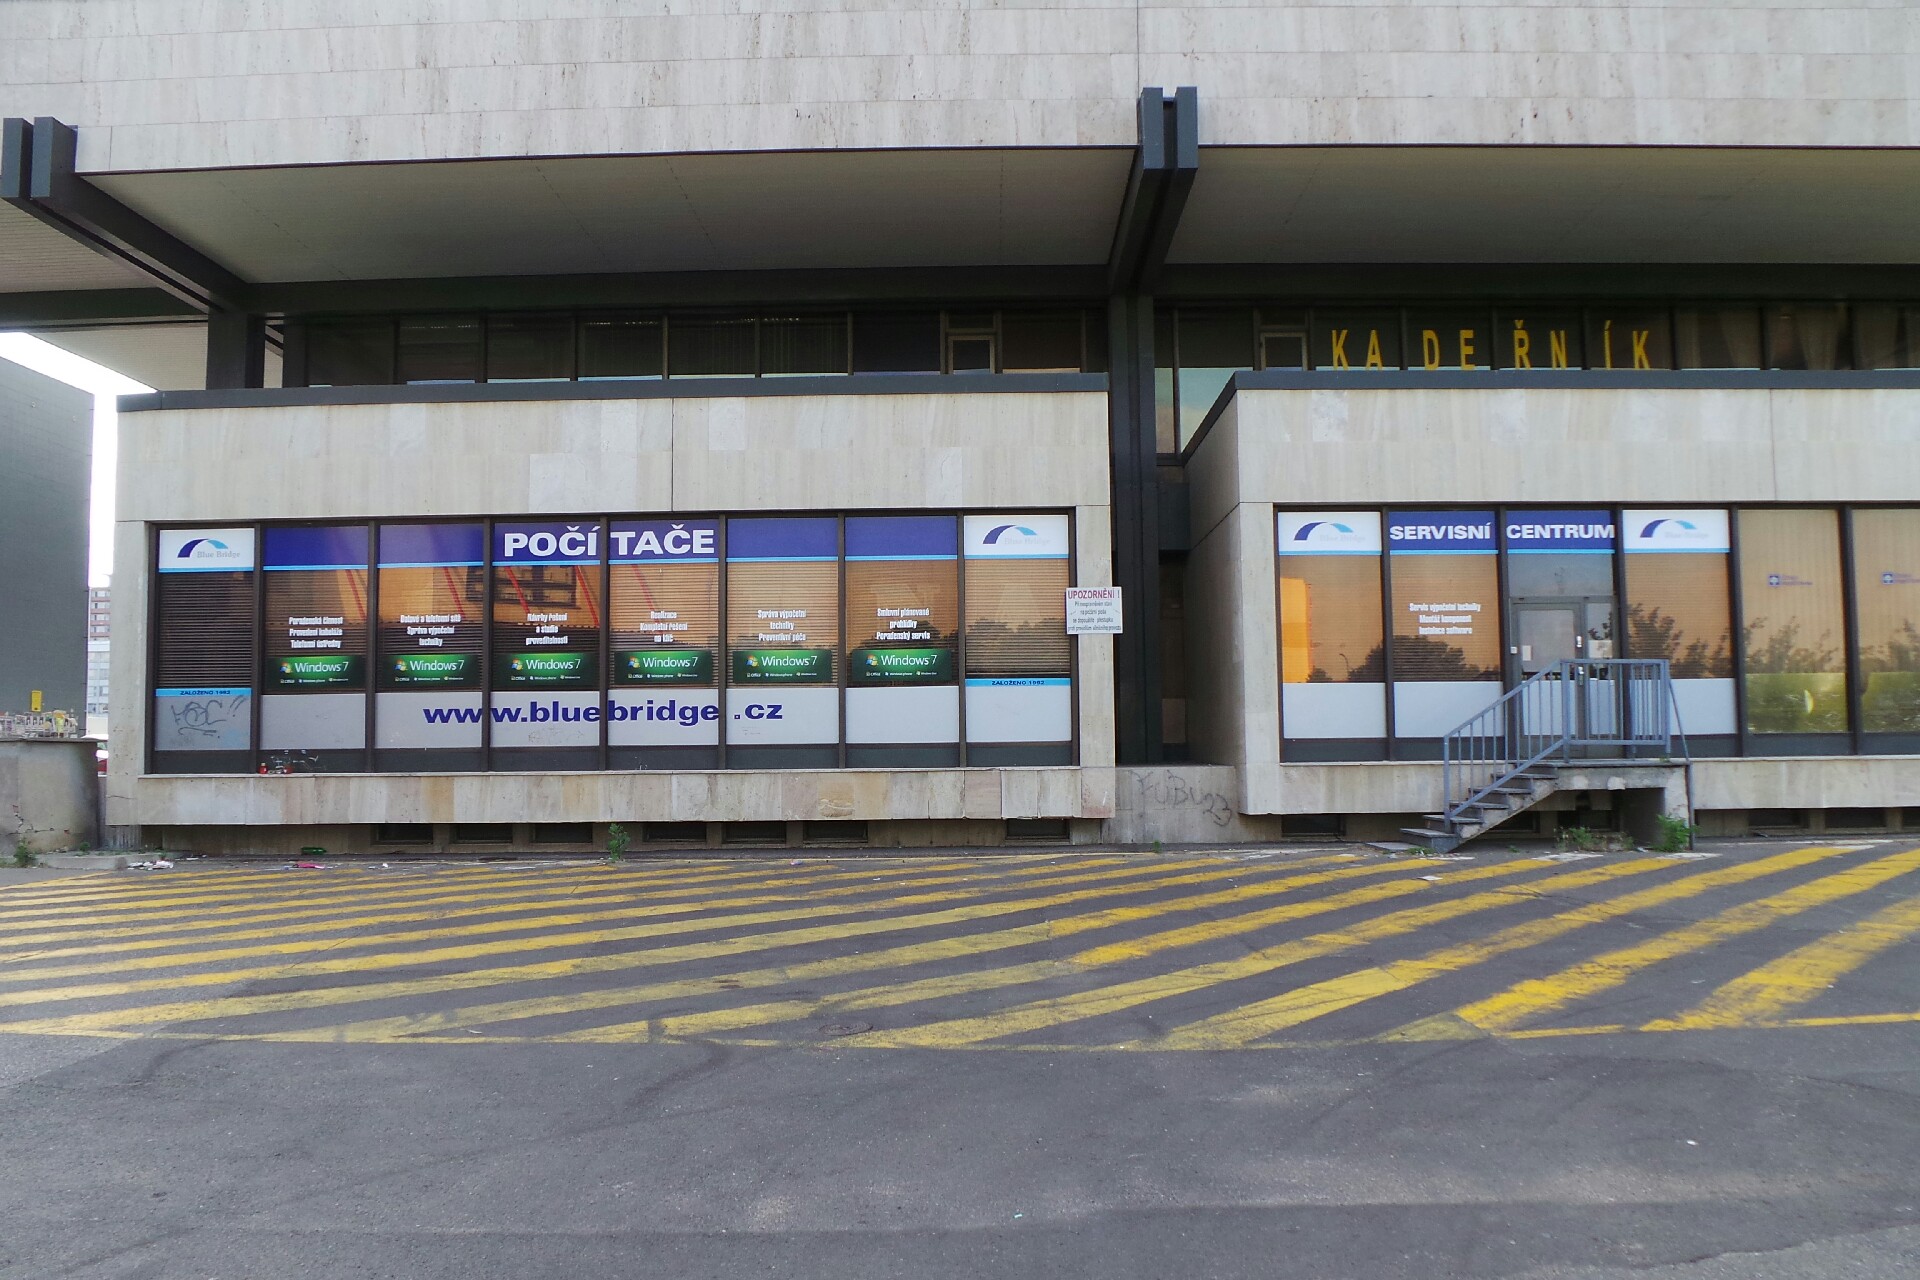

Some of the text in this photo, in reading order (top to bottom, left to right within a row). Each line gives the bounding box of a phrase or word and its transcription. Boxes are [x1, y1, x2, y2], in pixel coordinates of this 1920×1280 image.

[1331, 319, 1651, 369] KADEŘNÍK
[1390, 522, 1615, 540] SERVISNÍ CENTRUM
[197, 550, 240, 560] Blue Bridge
[1068, 588, 1115, 599] UPOZORNĚNÍ
[410, 660, 465, 671] Windows 7
[526, 659, 581, 670] Windows 7
[643, 657, 698, 668] Windows 7
[761, 656, 817, 666] Windows 7
[881, 655, 937, 666] Windows 7
[295, 662, 349, 673] Windows 7
